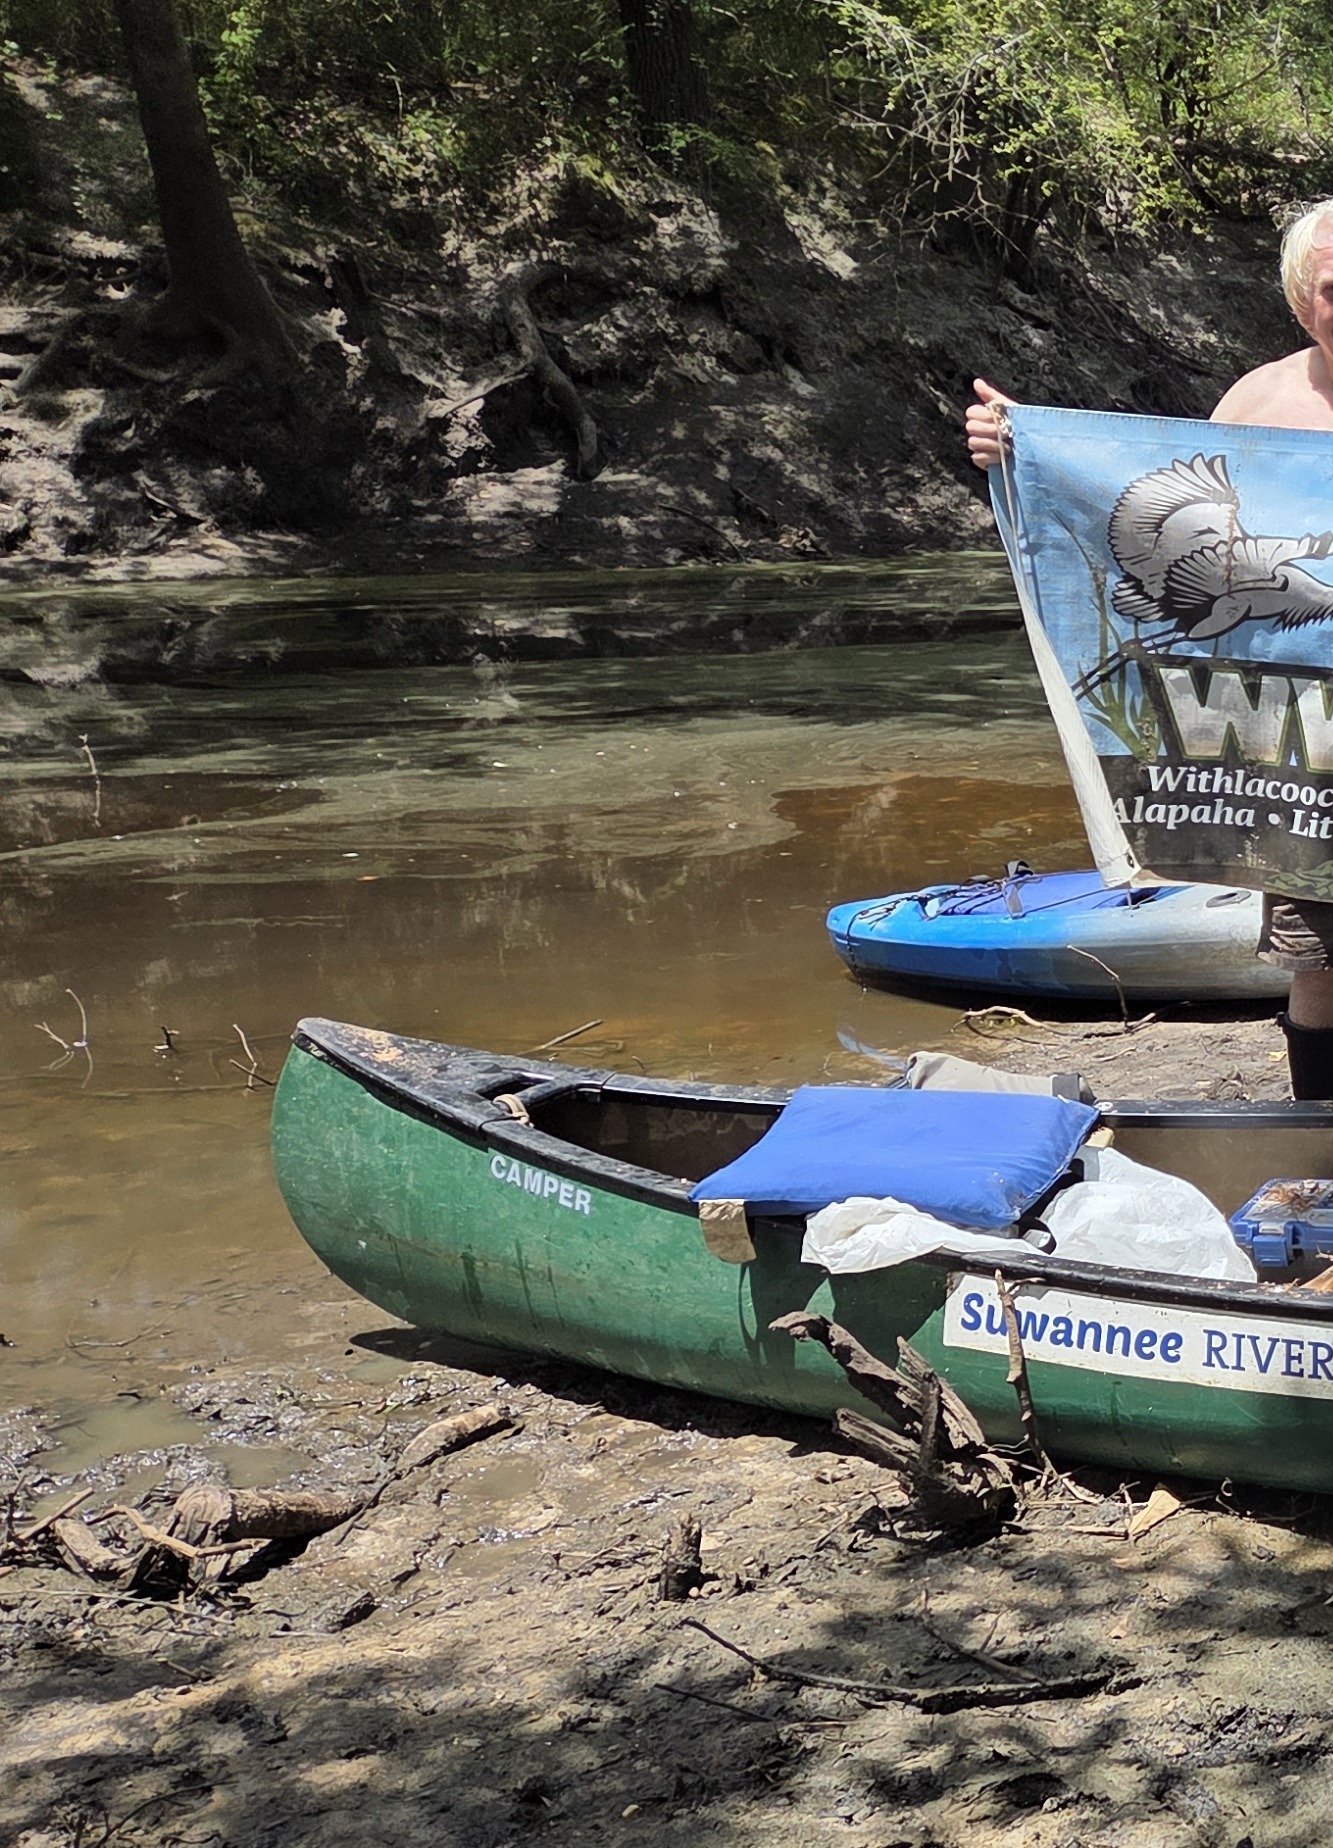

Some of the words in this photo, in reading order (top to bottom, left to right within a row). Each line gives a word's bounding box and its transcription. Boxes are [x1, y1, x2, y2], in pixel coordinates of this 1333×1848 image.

[1112, 795, 1256, 830] Alapaha
[490, 1154, 592, 1216] CAMPER
[960, 1292, 1184, 1364] Suwannee
